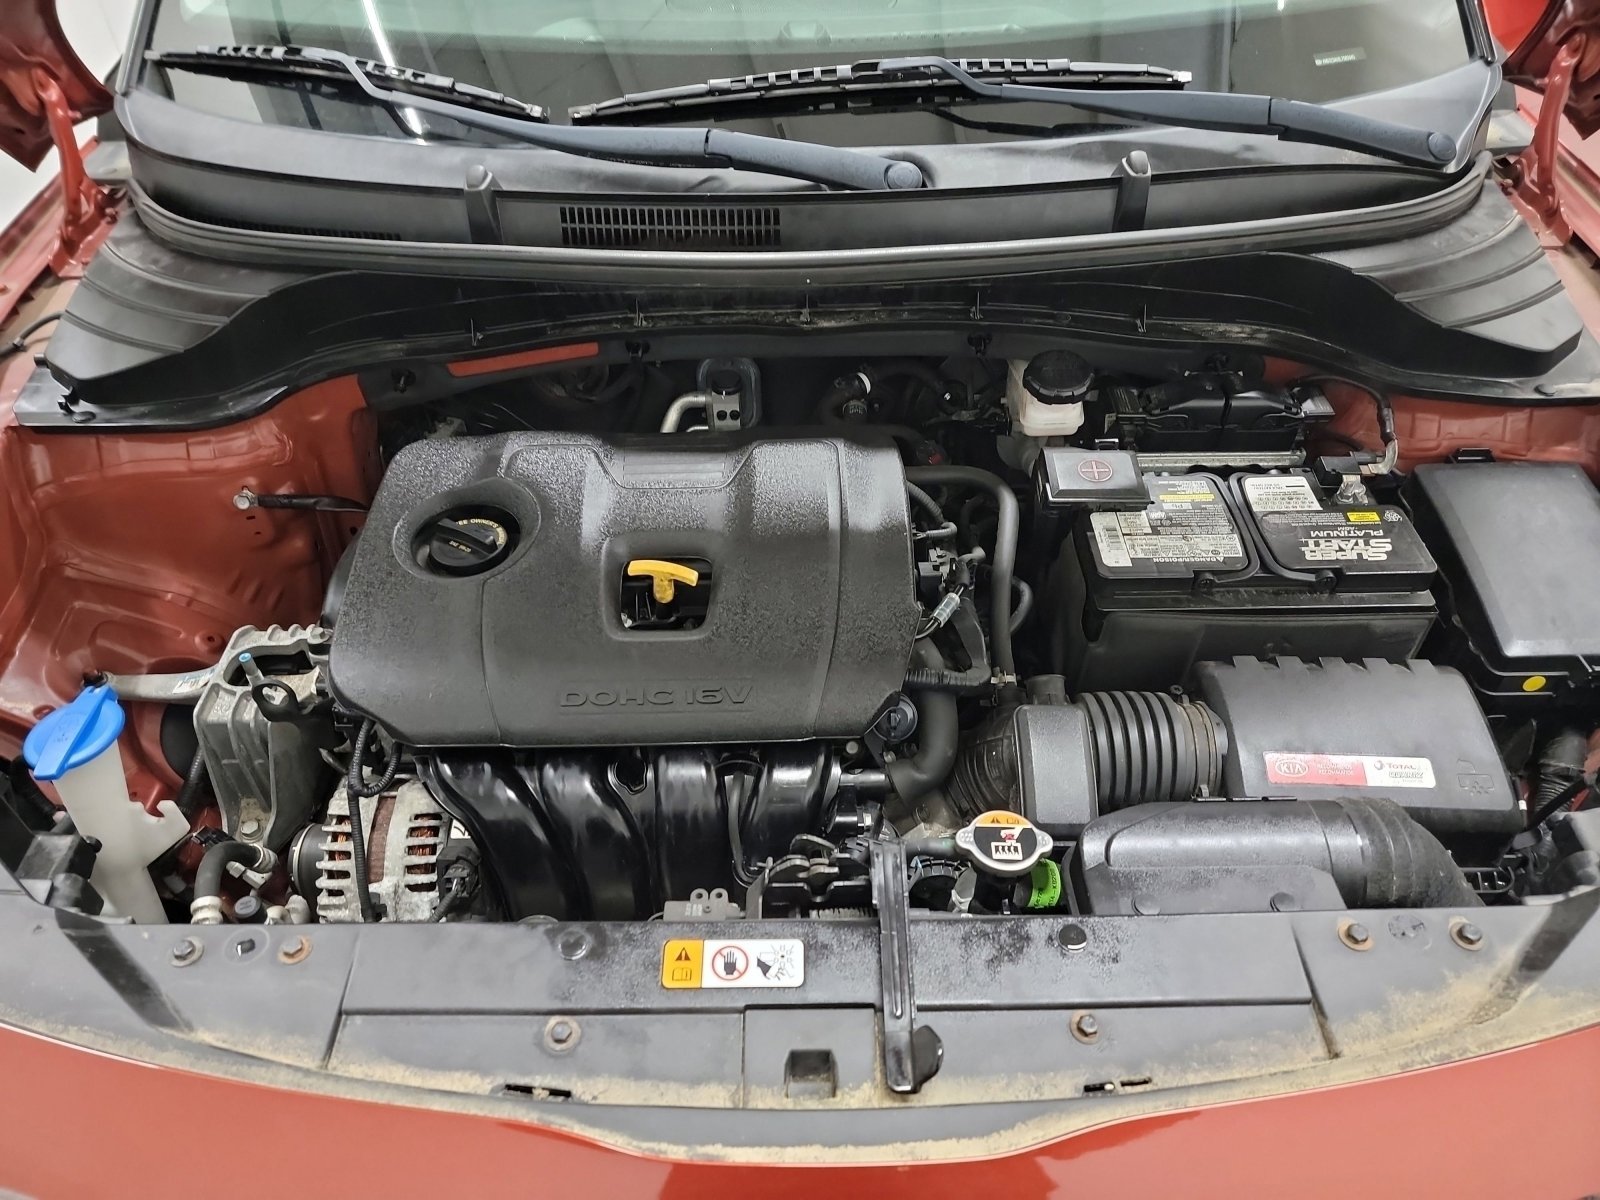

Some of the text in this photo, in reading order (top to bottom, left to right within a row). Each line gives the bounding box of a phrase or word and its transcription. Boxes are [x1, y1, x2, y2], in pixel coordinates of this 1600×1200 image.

[1310, 529, 1384, 538] PLATINUM
[1300, 538, 1392, 552] START
[1304, 549, 1388, 561] SUPER
[560, 686, 753, 707] DOHC 16V
[1279, 762, 1305, 775] KIA
[1385, 762, 1417, 770] TOTAL
